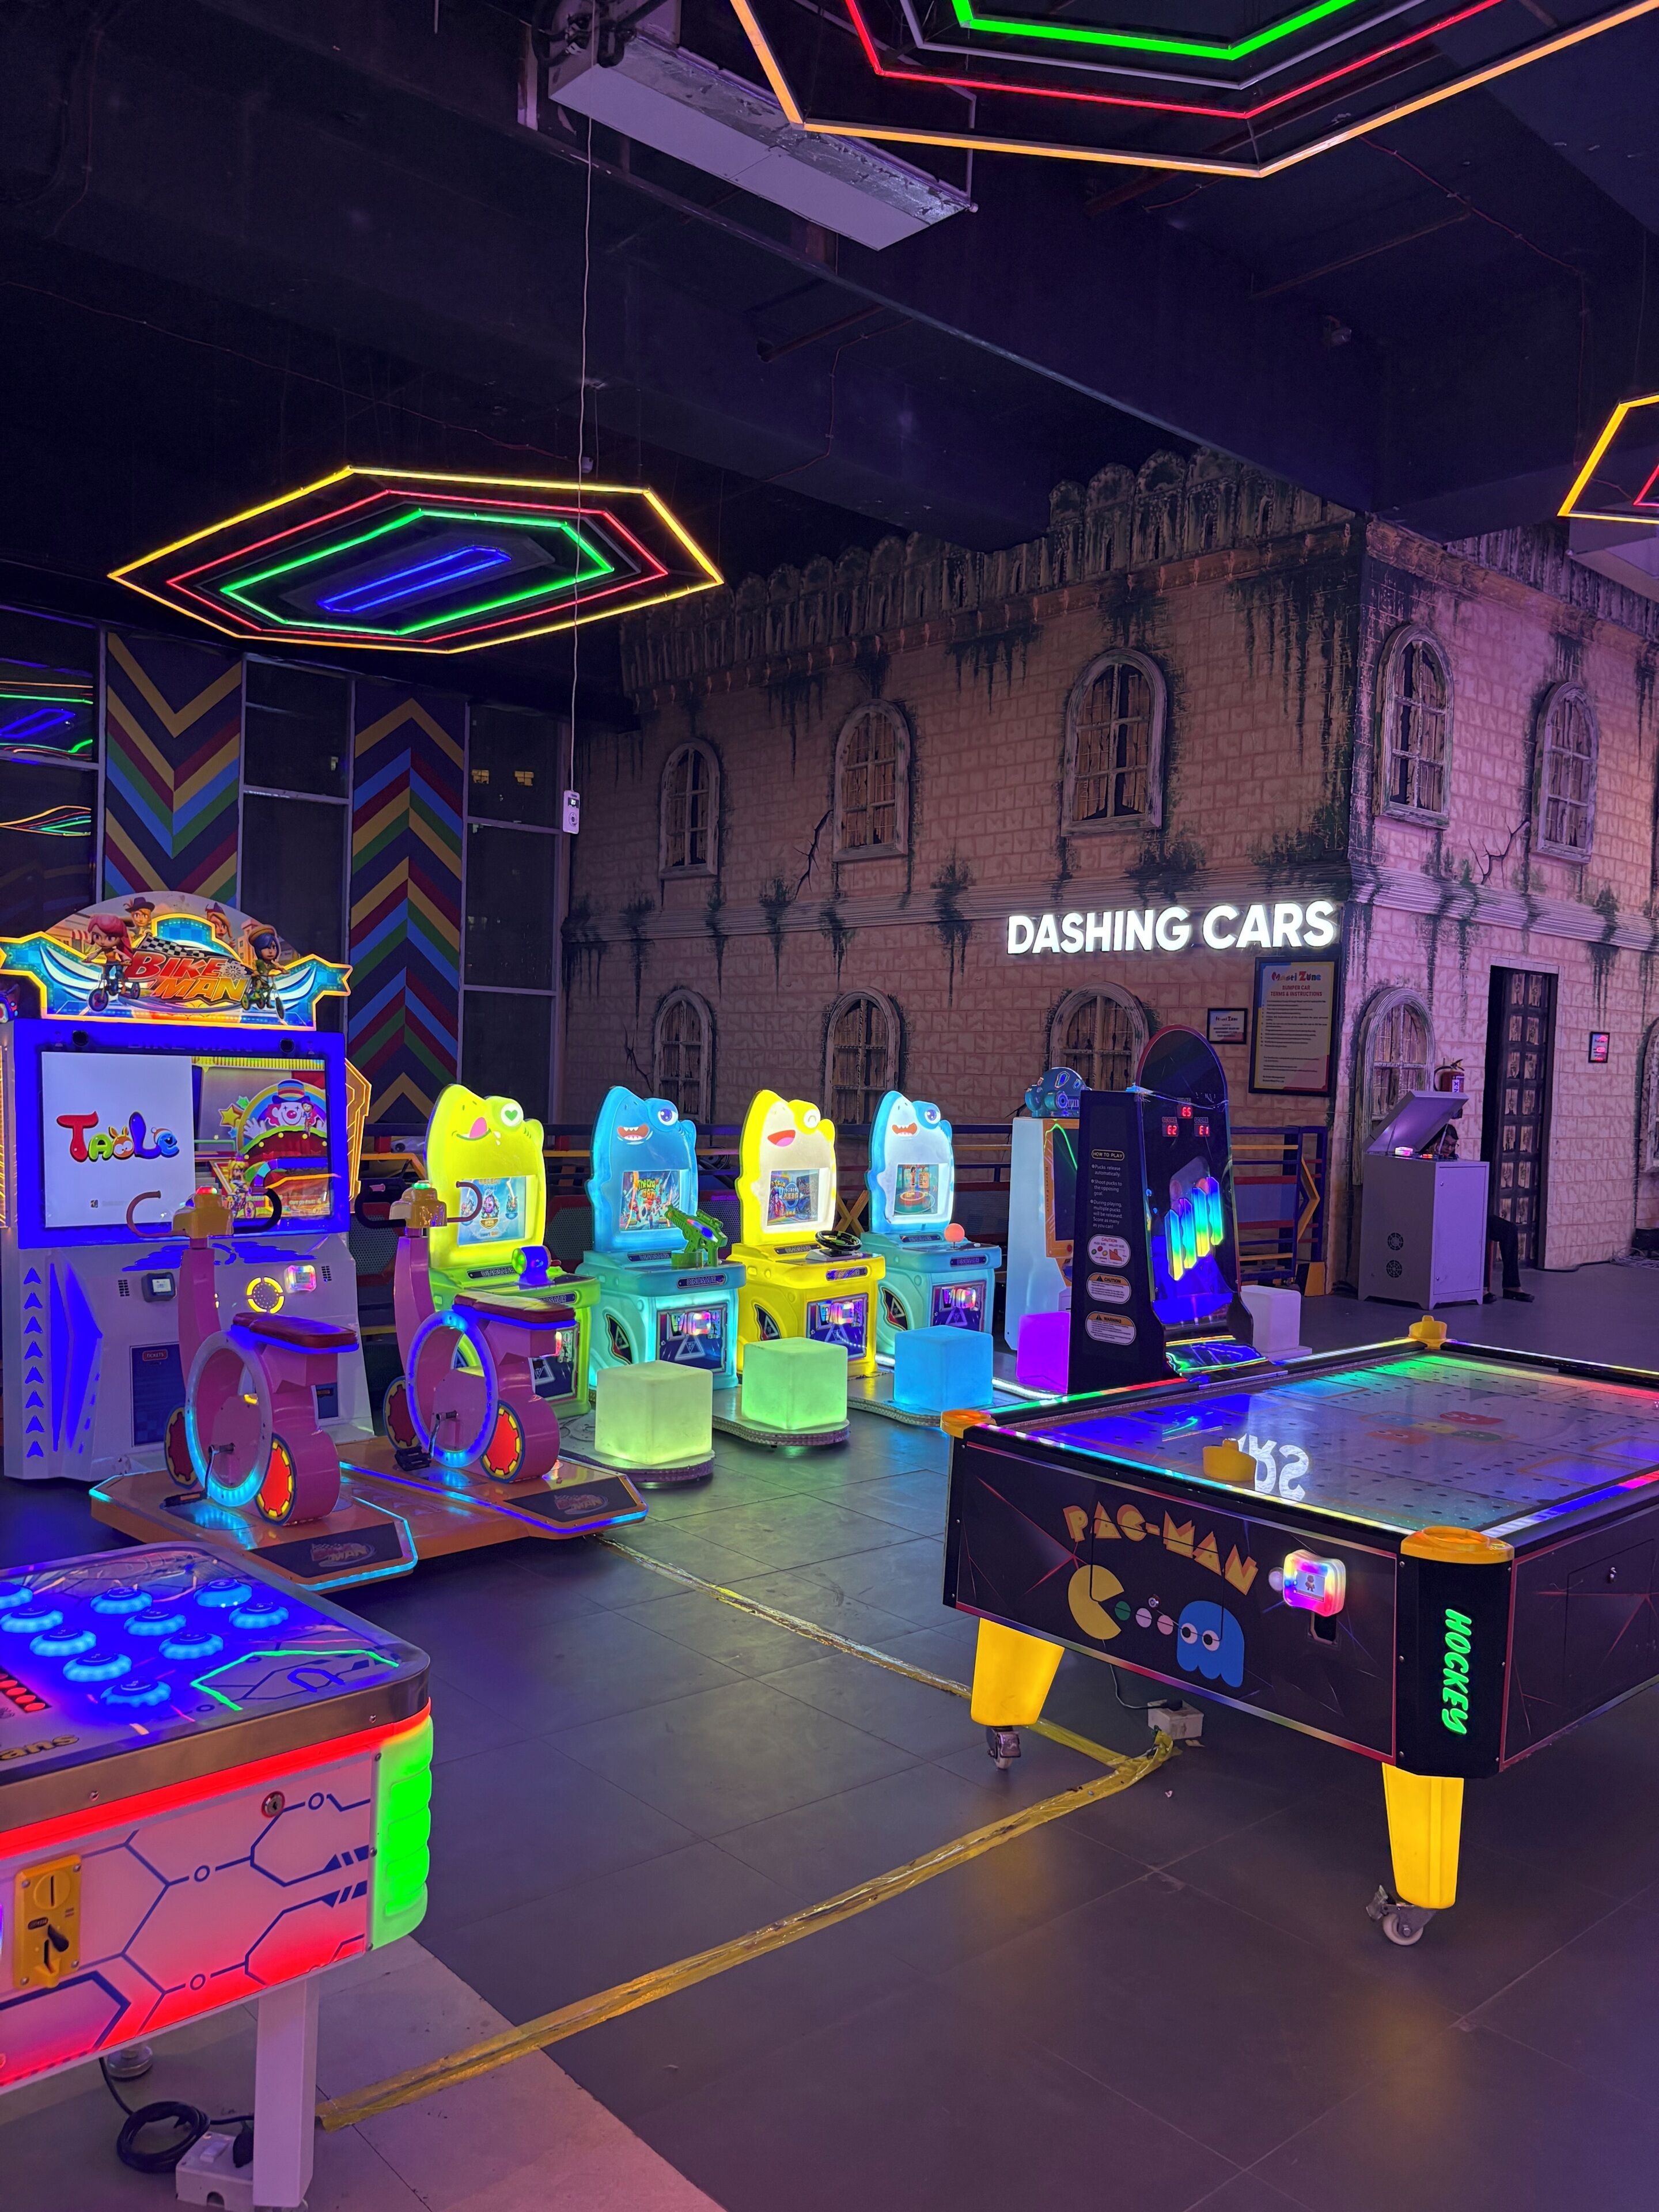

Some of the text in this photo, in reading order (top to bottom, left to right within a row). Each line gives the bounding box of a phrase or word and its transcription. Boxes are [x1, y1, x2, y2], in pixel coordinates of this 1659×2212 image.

[1007, 900, 1335, 955] DASHING CARS
[124, 950, 228, 979] BIKE
[150, 977, 251, 1002] MAN
[481, 1268, 515, 1277] DINOSAUR
[686, 1275, 717, 1286] DINOSAUR
[1062, 1501, 1259, 1596] PAC-MAN
[1441, 1608, 1472, 1734] HOCKEY
